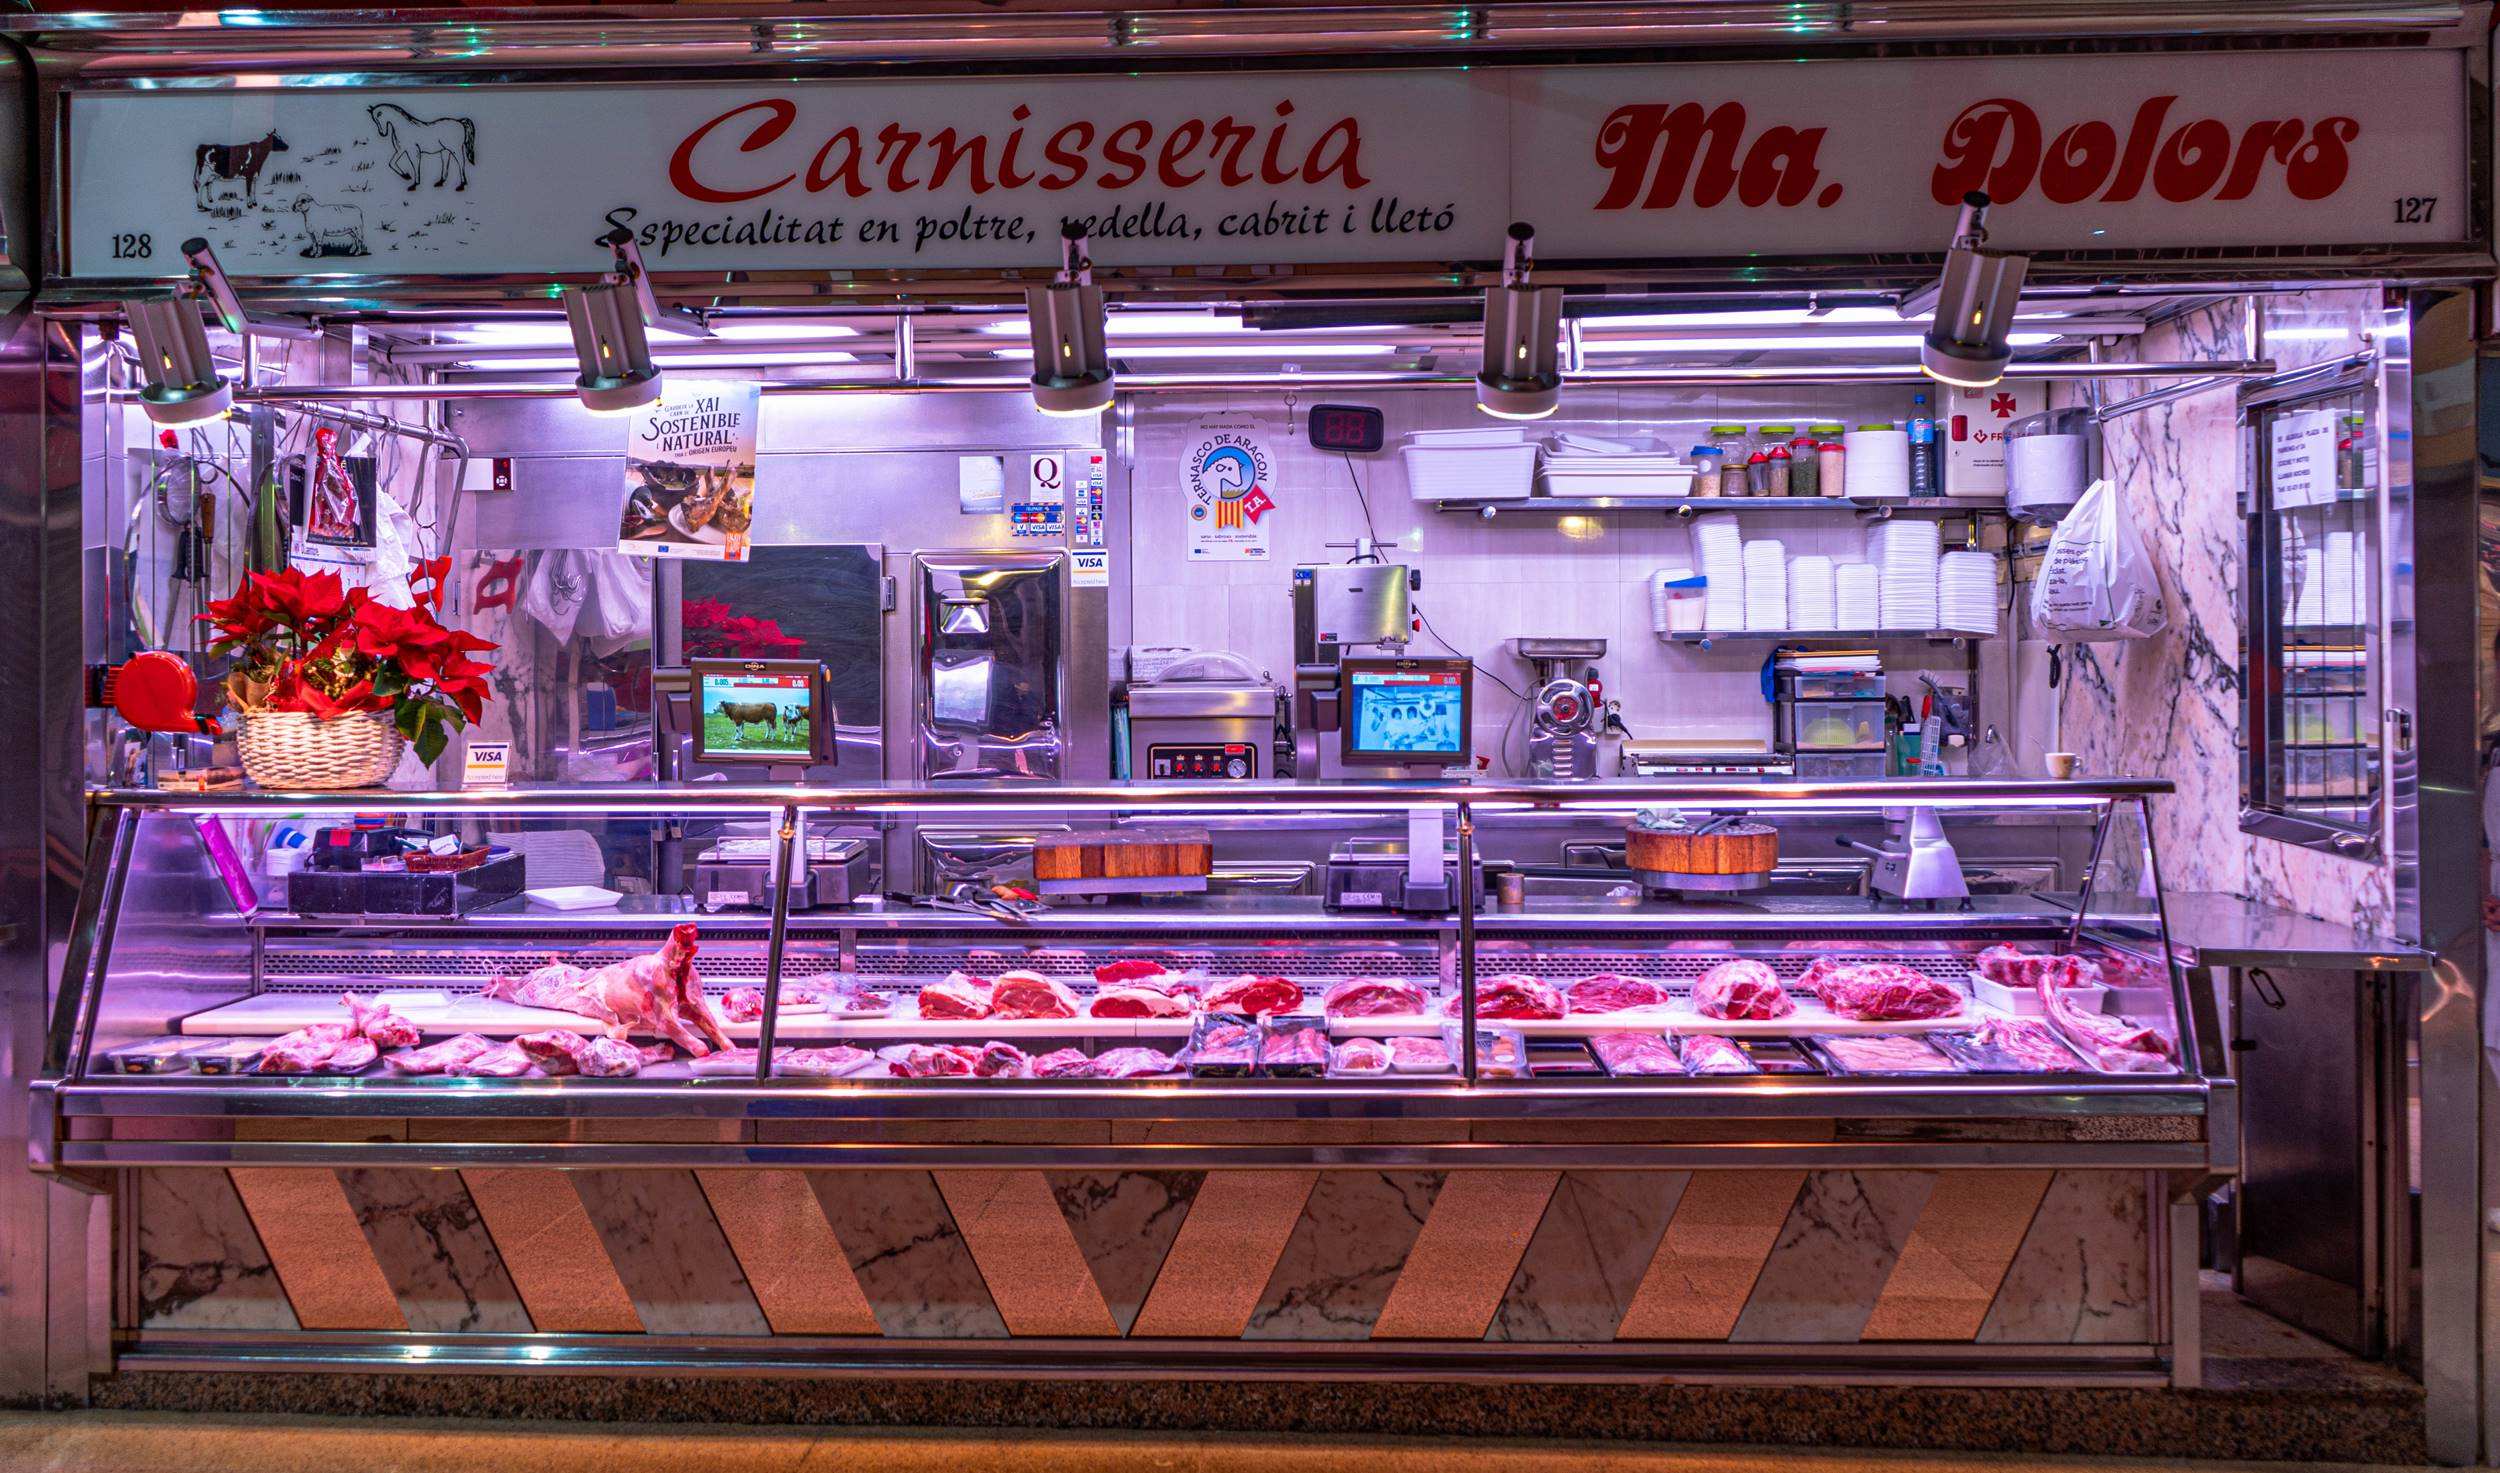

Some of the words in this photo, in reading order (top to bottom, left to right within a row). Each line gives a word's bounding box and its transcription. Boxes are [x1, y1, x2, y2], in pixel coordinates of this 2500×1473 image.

[669, 98, 1370, 203] Carnisseria
[1594, 101, 1843, 210] Ma.
[1931, 95, 2360, 207] Dolors
[2393, 197, 2438, 223] 127
[859, 219, 899, 243] en
[914, 205, 1036, 253] poltre,
[1217, 200, 1330, 238] cabrit
[1342, 205, 1357, 234] i
[1370, 197, 1455, 234] lletó
[112, 233, 152, 259] 128
[695, 397, 720, 414] XAI
[641, 412, 741, 442] SOSTENIBLE
[662, 429, 733, 452] NATURAL
[1034, 458, 1061, 489] Q
[1190, 441, 1212, 506] TERNASCO
[1214, 434, 1231, 445] DE
[1078, 557, 1103, 567] VISA
[474, 752, 502, 761] VISA
